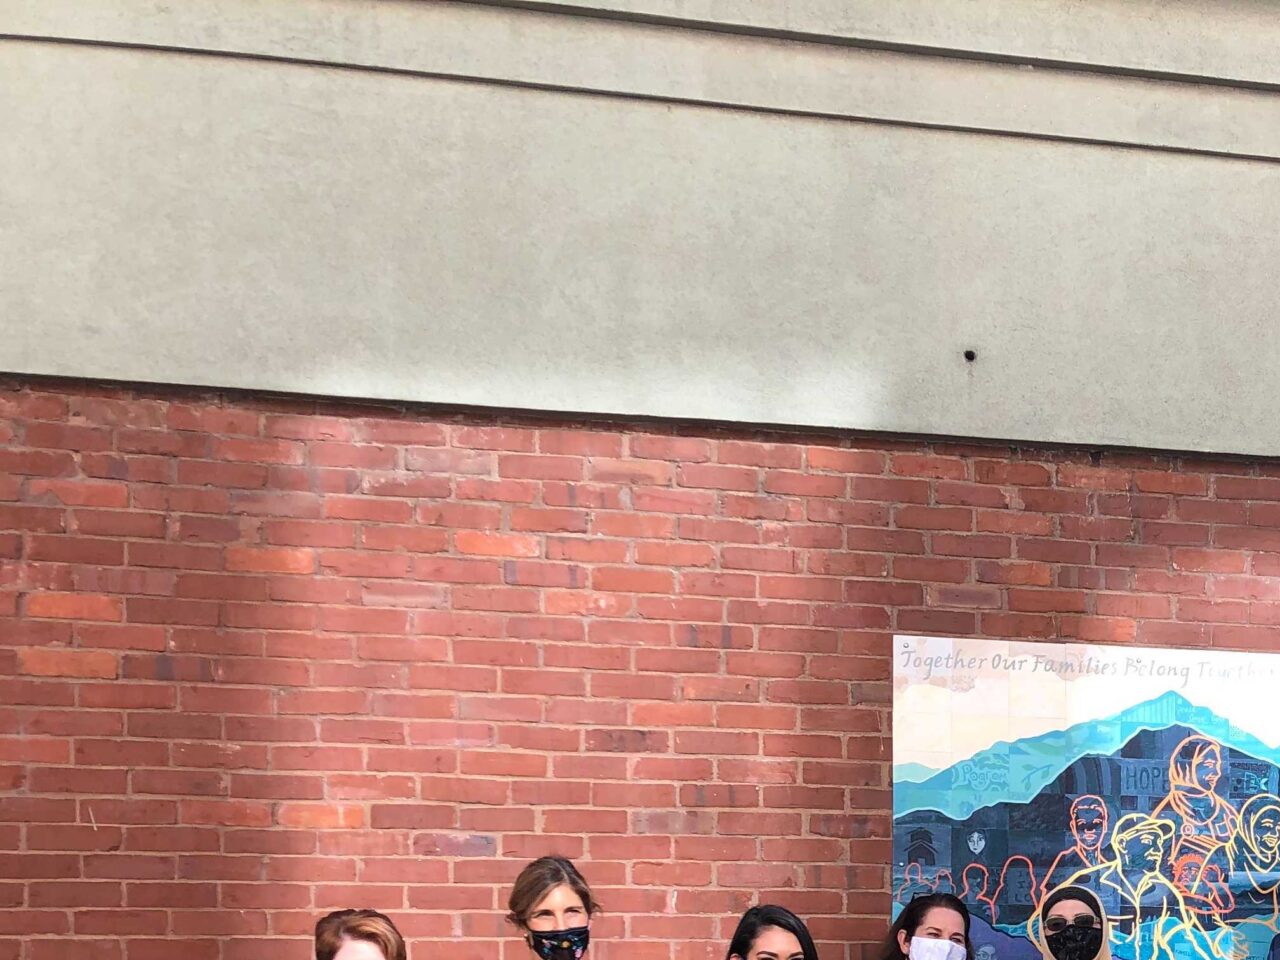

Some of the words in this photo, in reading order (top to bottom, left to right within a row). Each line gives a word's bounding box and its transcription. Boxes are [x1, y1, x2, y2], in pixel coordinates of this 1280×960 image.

[900, 648, 988, 681] Together
[991, 653, 1028, 671] Our
[1032, 654, 1118, 675] Families
[1126, 766, 1169, 793] HOPE
